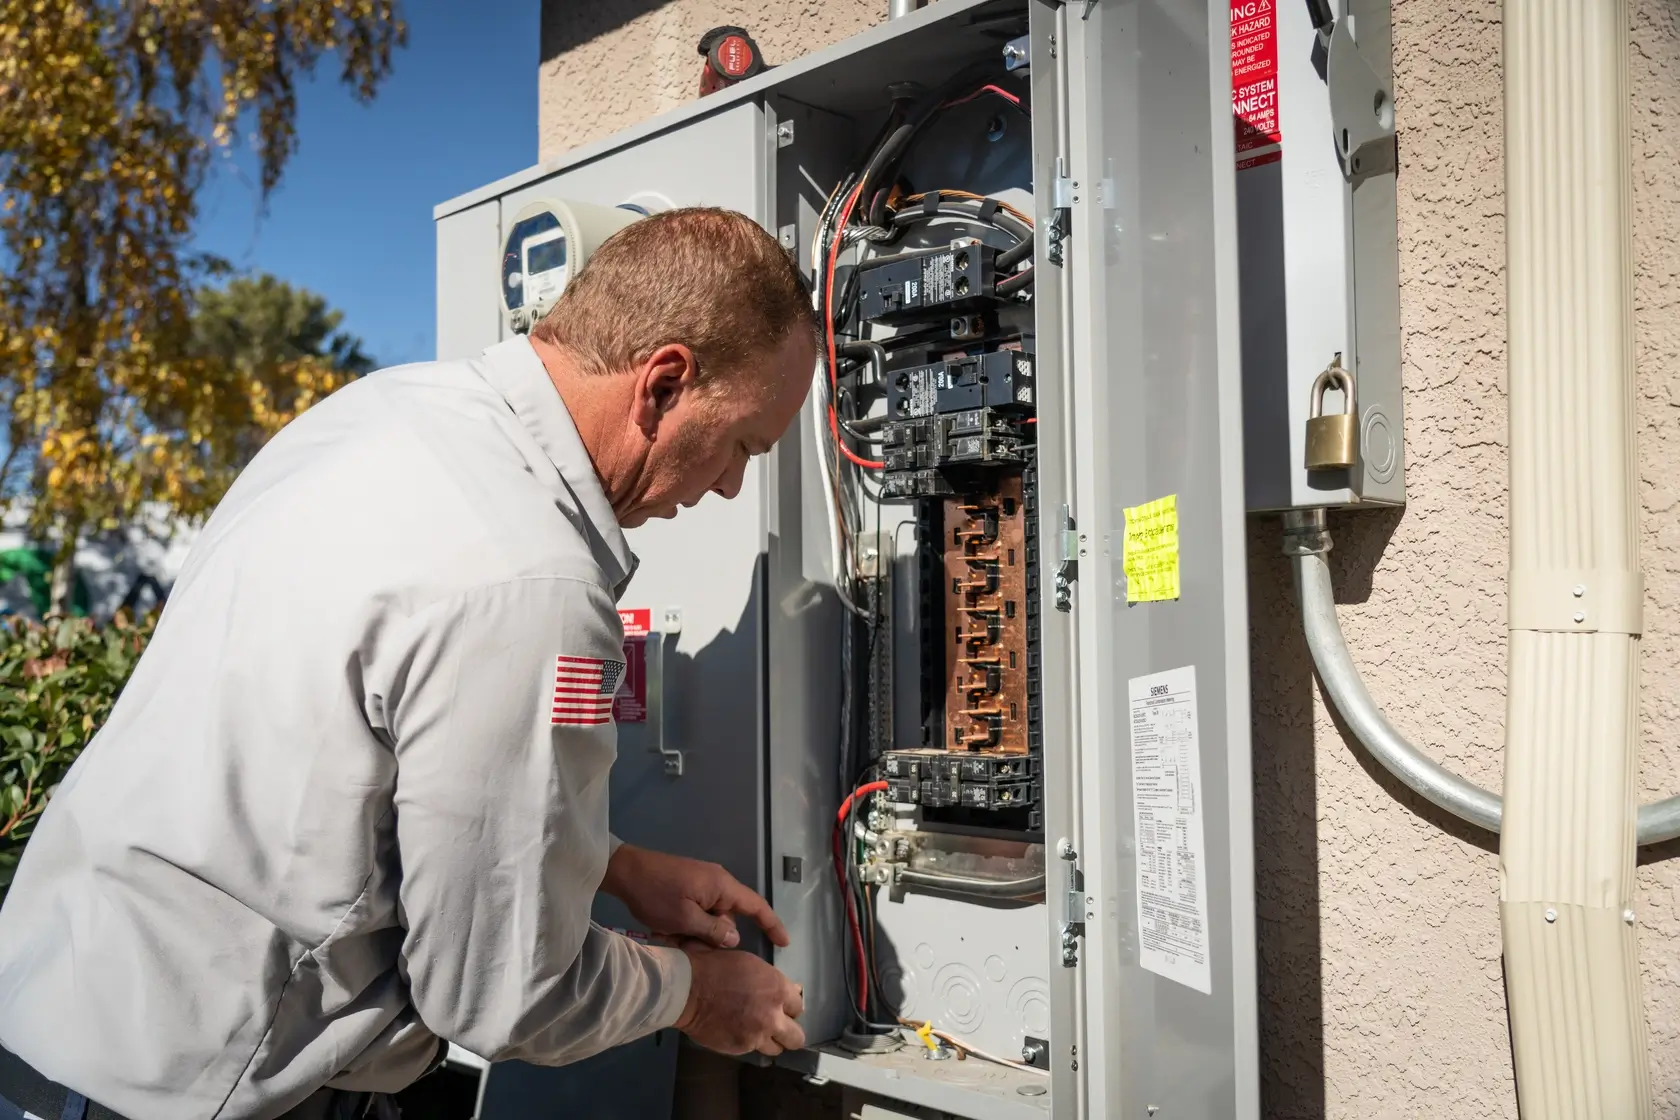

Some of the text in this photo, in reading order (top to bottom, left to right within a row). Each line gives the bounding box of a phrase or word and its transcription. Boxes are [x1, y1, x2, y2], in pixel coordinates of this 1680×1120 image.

[1230, 2, 1256, 22] ING
[1230, 16, 1271, 37] K HAZARD
[1236, 31, 1271, 48] INDICATED
[1230, 43, 1264, 58] ROUNDED
[1246, 54, 1256, 63] BE
[1234, 59, 1271, 76] ENERGIZED
[1238, 78, 1274, 99] SYSTEM
[1232, 91, 1276, 115] NNECT
[1256, 108, 1275, 120] AMPS
[1254, 120, 1275, 132] VOLTS
